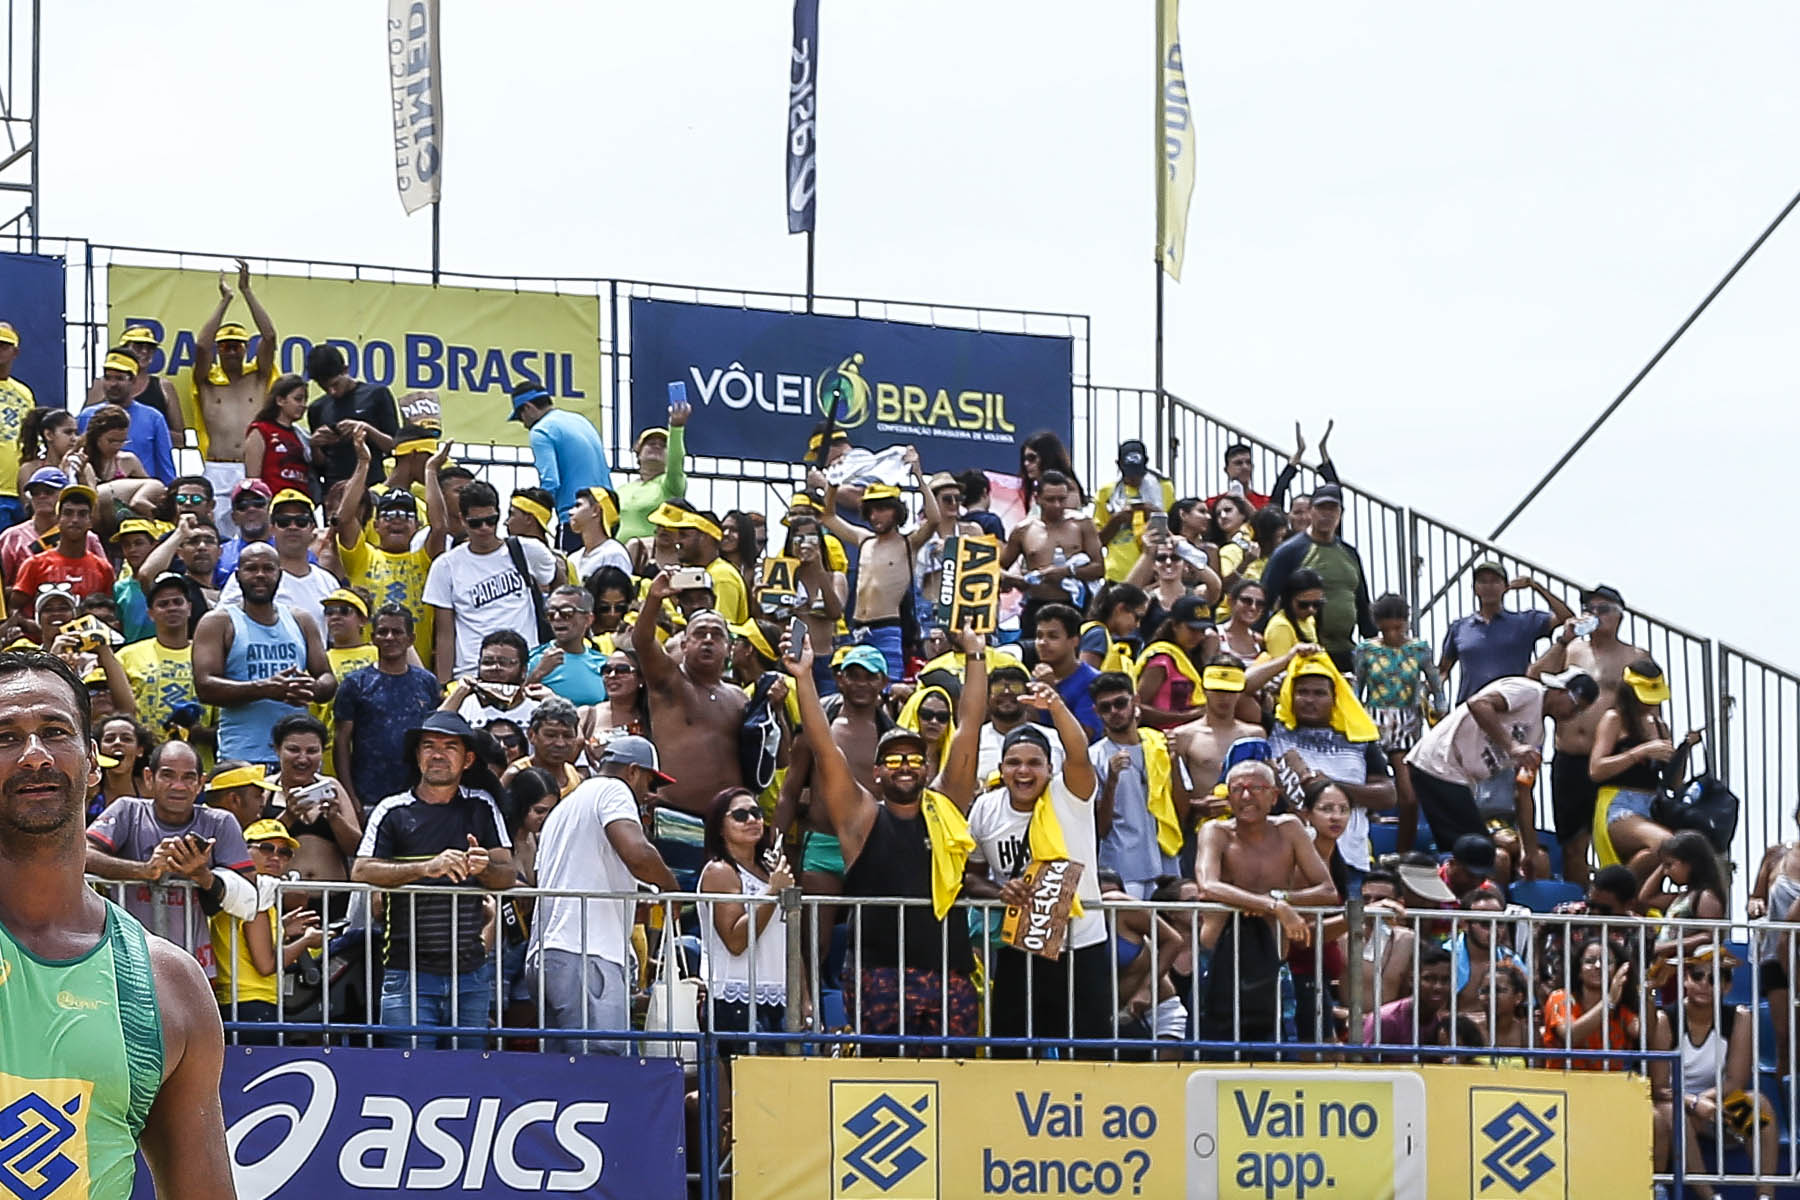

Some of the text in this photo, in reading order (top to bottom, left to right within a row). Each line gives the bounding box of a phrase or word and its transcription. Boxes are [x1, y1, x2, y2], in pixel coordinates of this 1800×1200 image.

[404, 332, 586, 399] BRASIL
[689, 361, 812, 415] VÔLEI
[876, 382, 1016, 432] BRASIL
[471, 570, 522, 609] PATRIOTS
[940, 558, 954, 606] CIMED
[954, 540, 997, 632] ACE
[247, 643, 296, 662] ATMOS
[1023, 860, 1069, 951] PAREDÃO
[1015, 1090, 1158, 1140] Vai ao
[1235, 1089, 1379, 1139] Vai no
[338, 1095, 610, 1192] asics
[982, 1147, 1151, 1197] banco?
[1235, 1153, 1336, 1200] app.
